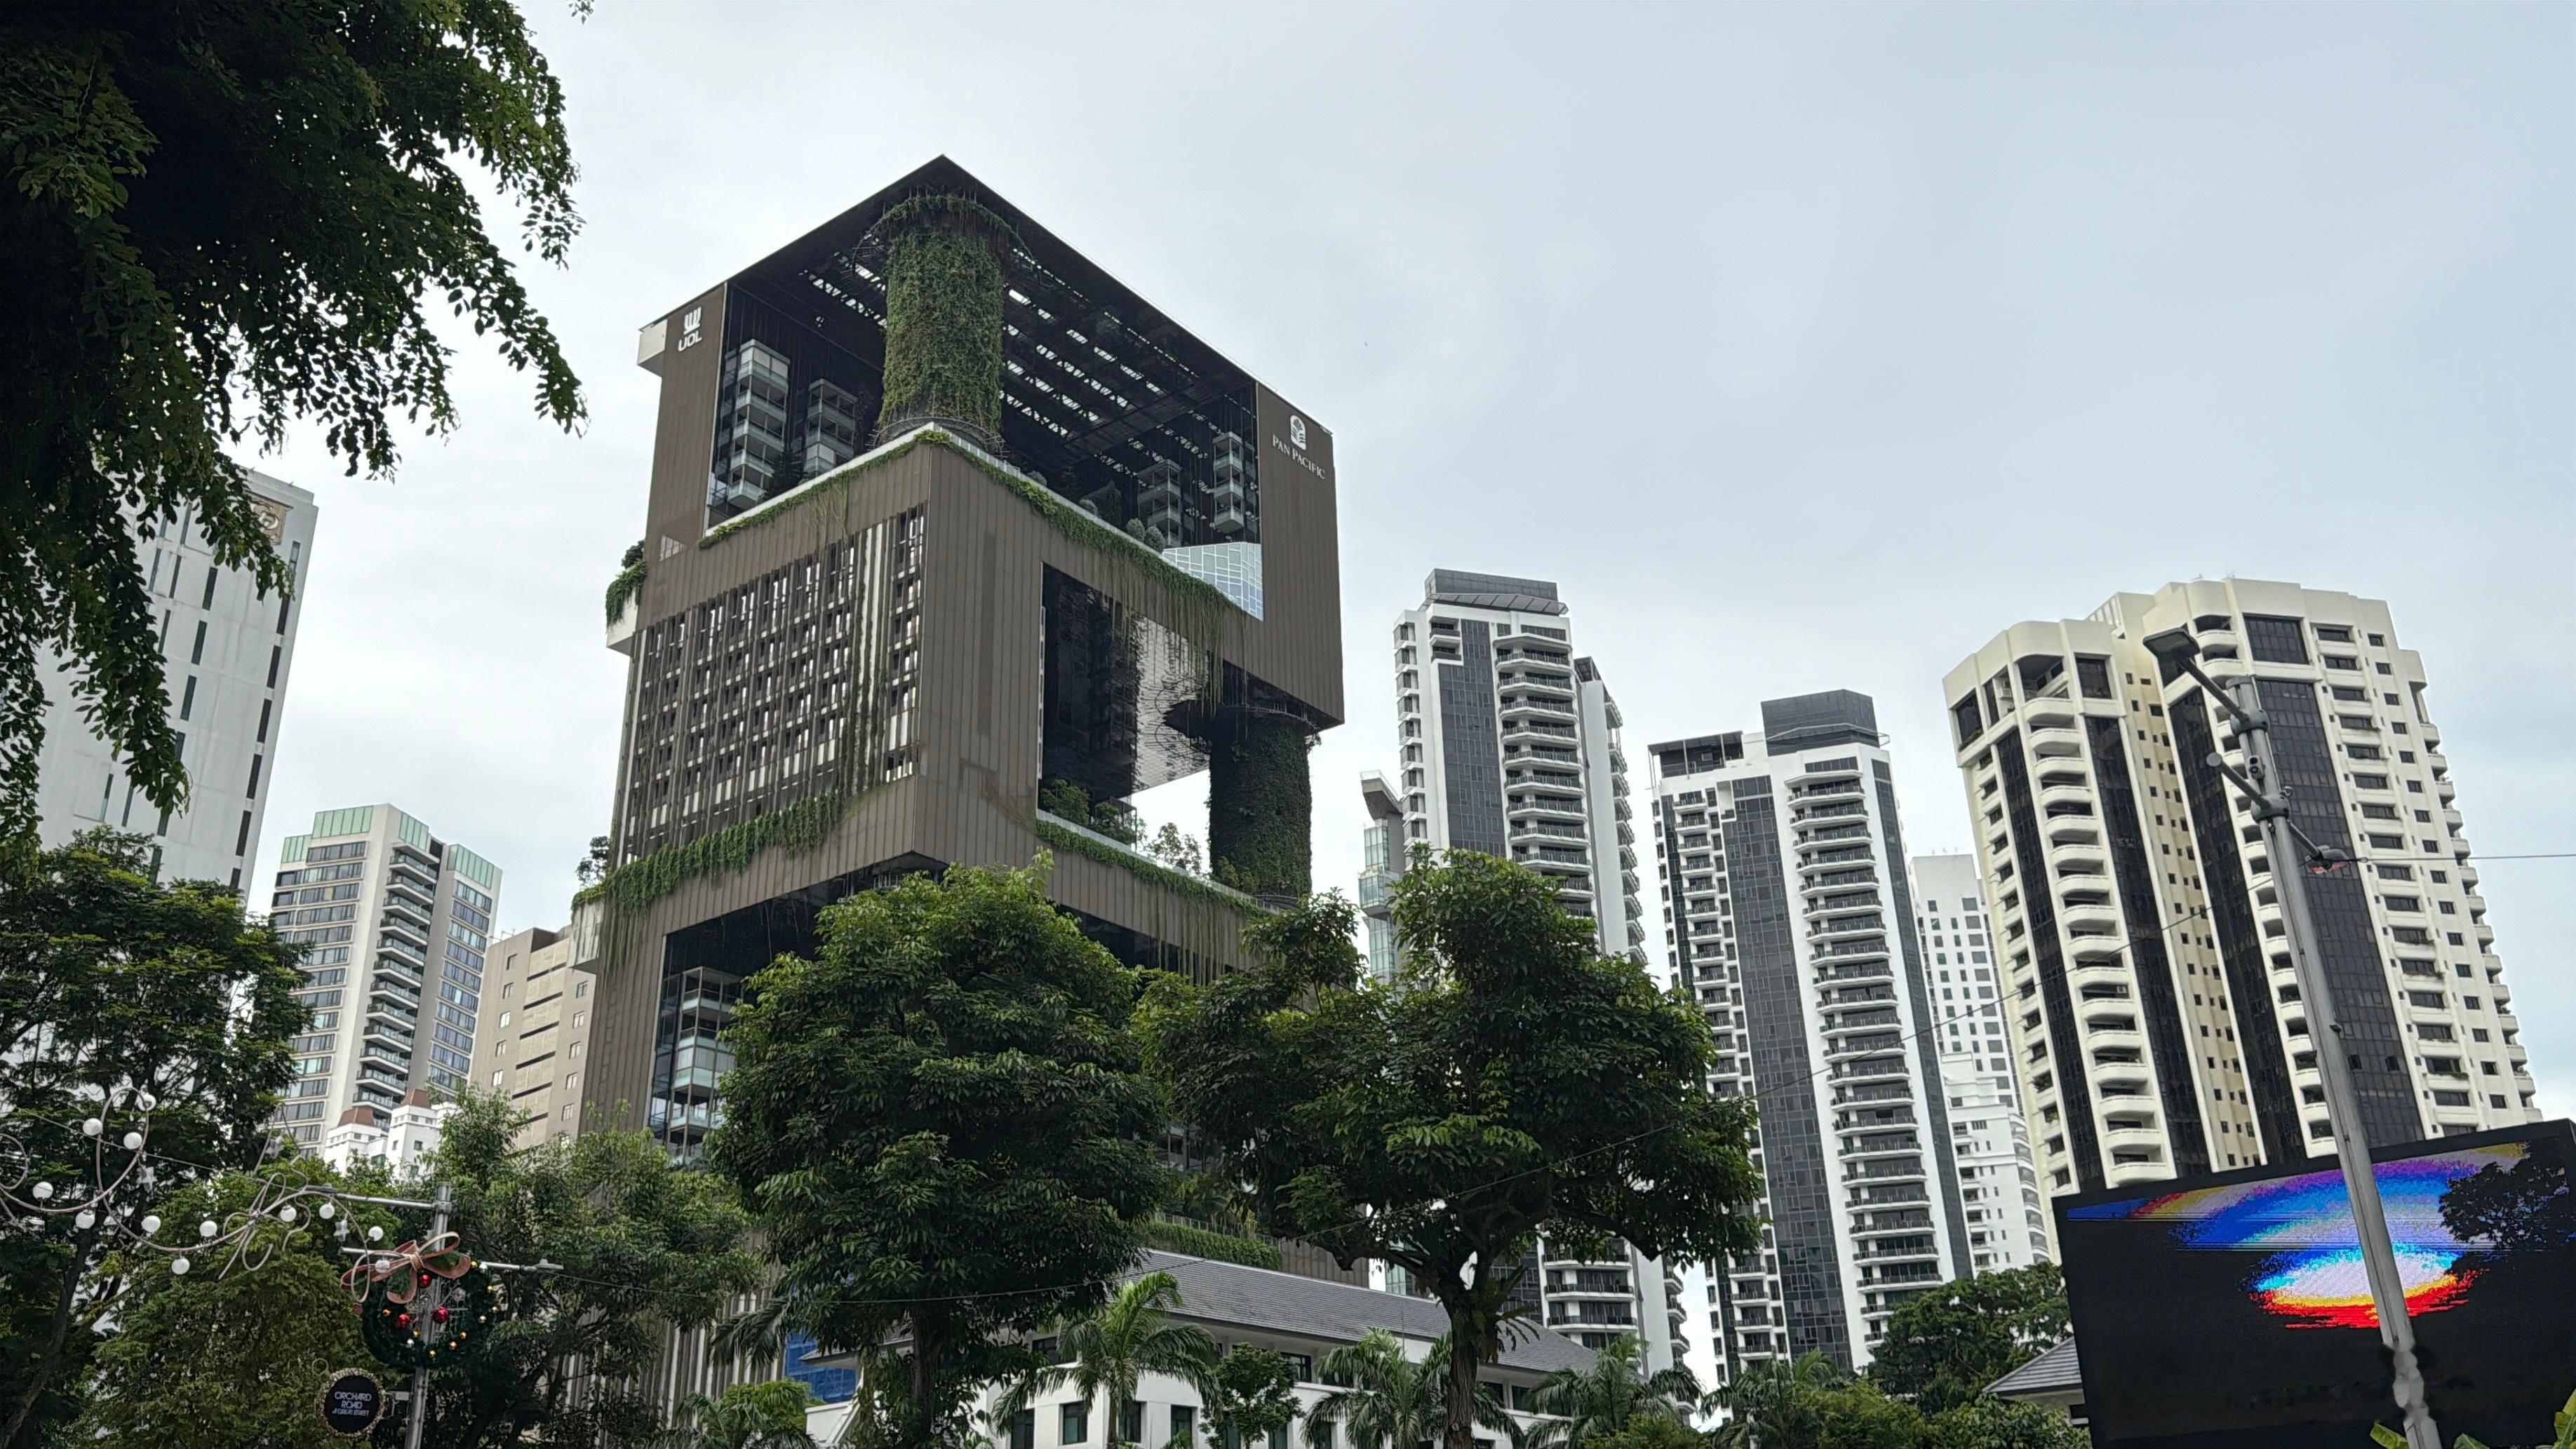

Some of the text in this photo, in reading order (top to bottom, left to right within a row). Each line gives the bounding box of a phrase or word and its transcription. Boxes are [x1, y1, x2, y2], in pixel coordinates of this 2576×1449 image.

[678, 330, 702, 352] UOL
[1273, 434, 1325, 480] PAN PACIFIC
[334, 1391, 372, 1401] ORCHARD
[341, 1400, 363, 1409] ROAD
